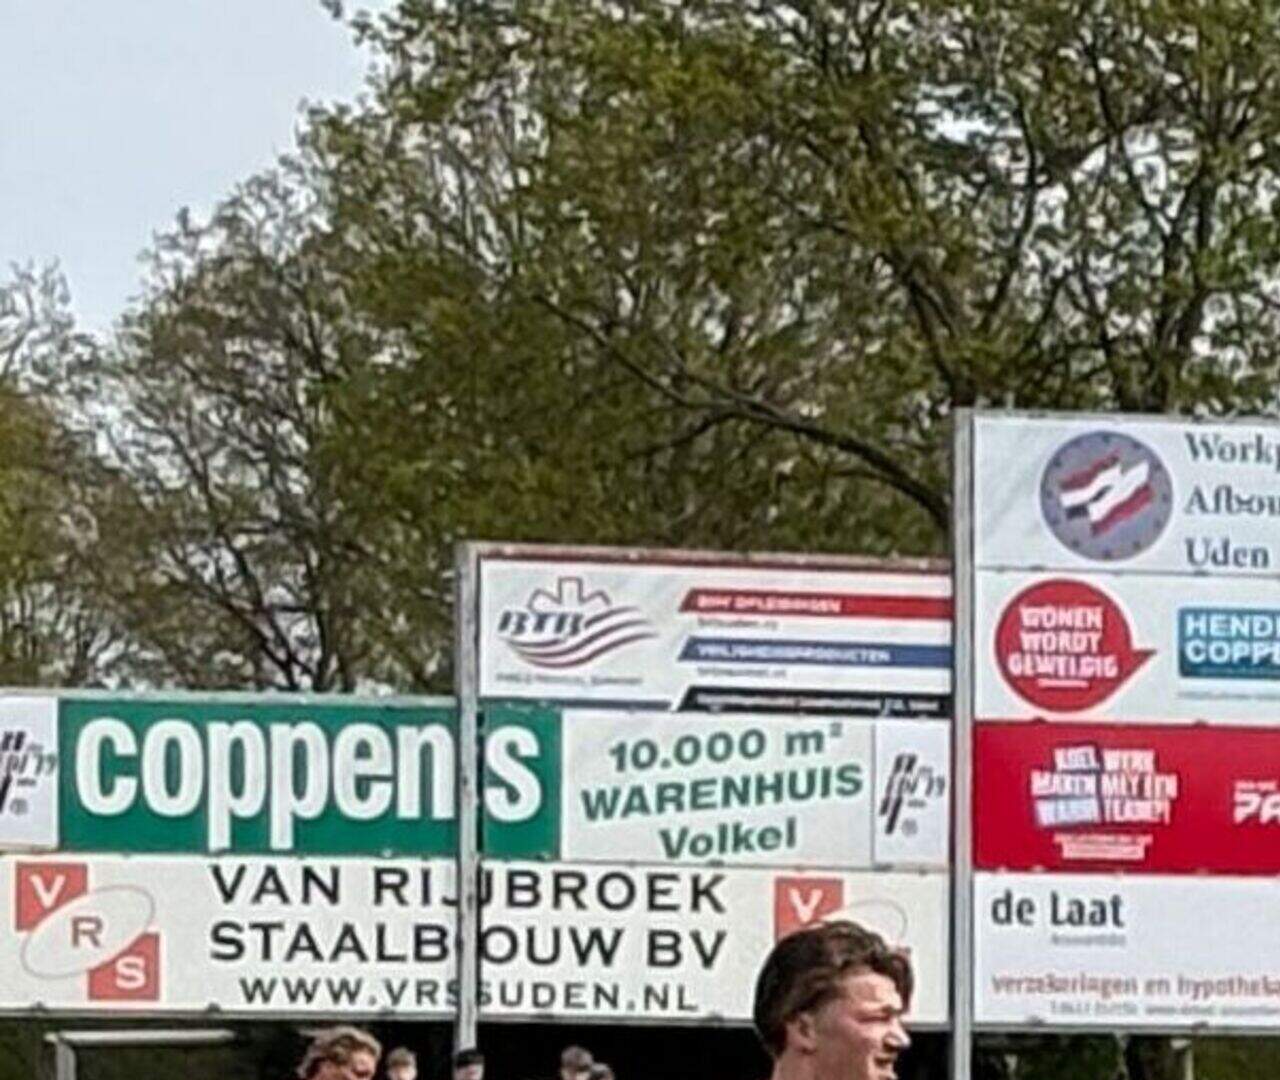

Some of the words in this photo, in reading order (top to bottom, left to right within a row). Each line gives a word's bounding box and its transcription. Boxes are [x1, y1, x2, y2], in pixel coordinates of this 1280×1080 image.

[1184, 538, 1271, 569] Uden
[608, 730, 767, 774] 10.000
[74, 712, 543, 850] coppens
[581, 763, 867, 824] WARENHUIS
[658, 819, 799, 862] Volkel
[29, 874, 66, 910] V
[209, 865, 339, 906] VAN
[991, 888, 1036, 926] de
[1049, 891, 1125, 927] Laat
[70, 914, 105, 950] R
[209, 922, 628, 969] STAALBOUW
[646, 928, 729, 973] BV
[114, 954, 147, 991] S
[1145, 978, 1171, 996] en
